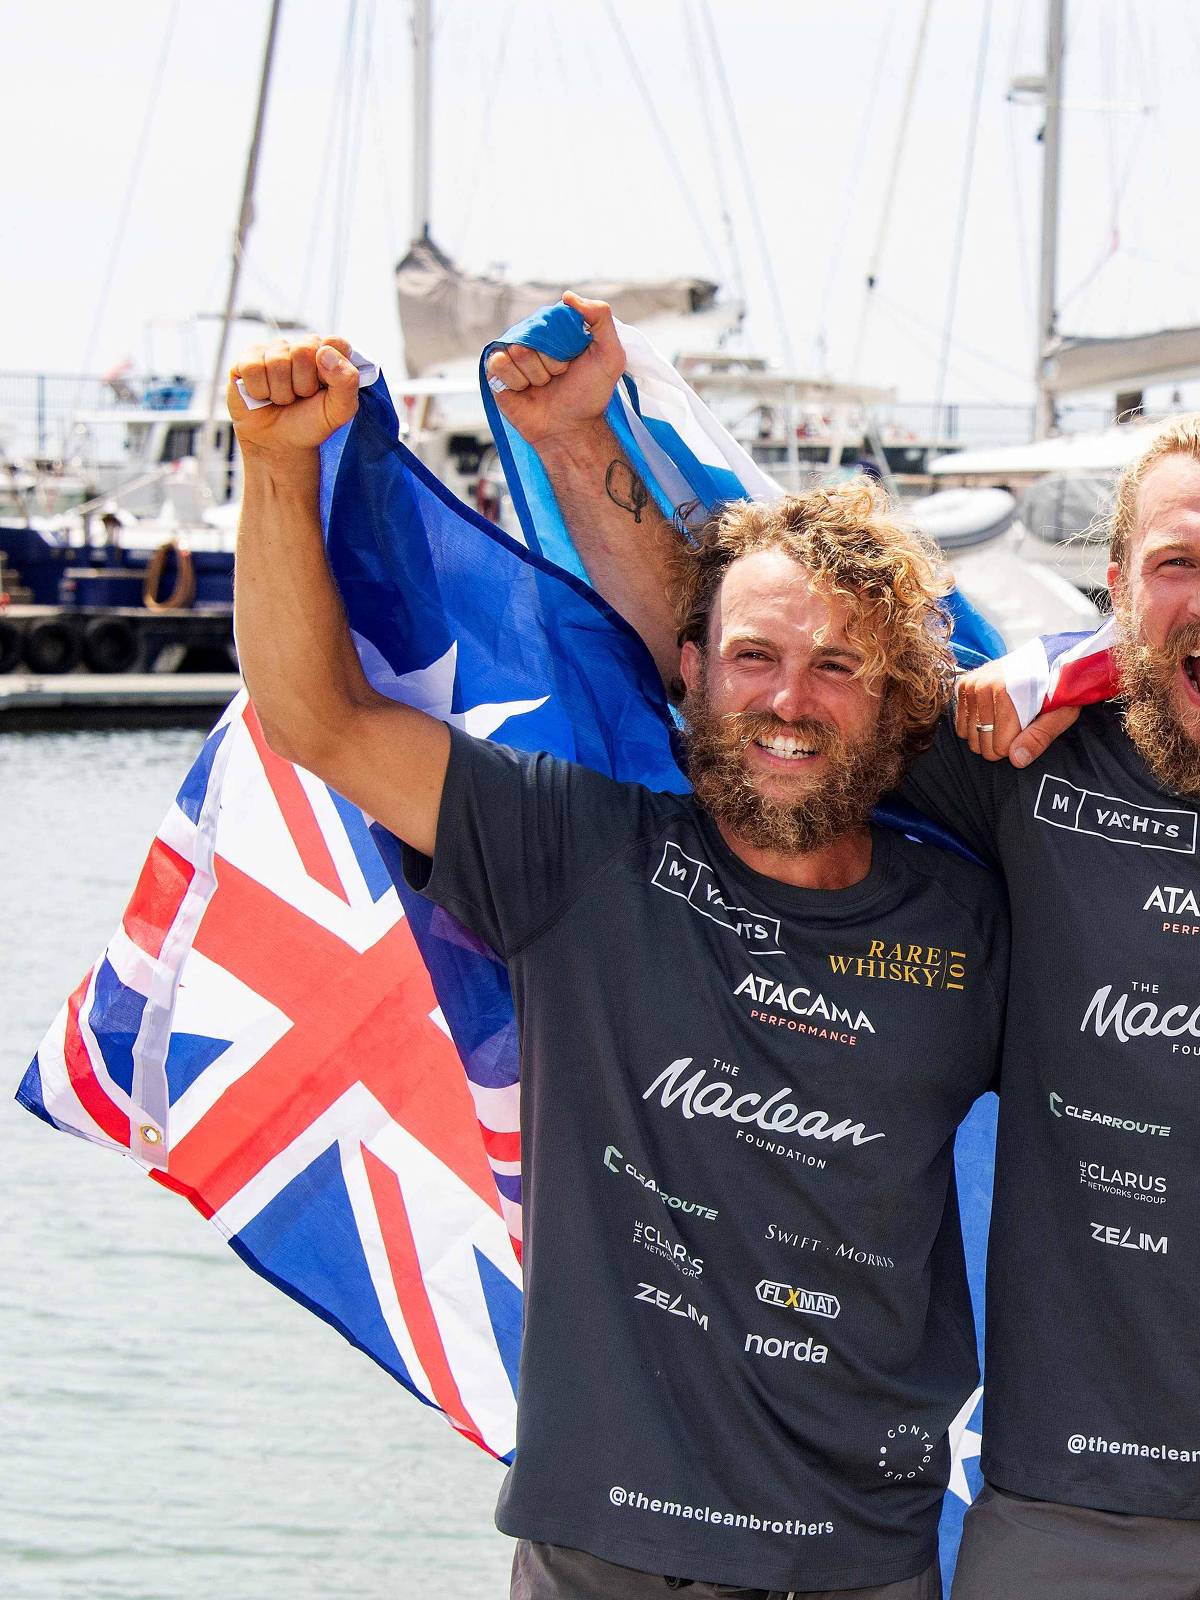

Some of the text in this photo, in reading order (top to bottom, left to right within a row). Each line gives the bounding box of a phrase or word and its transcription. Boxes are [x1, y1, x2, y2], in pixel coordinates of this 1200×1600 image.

[1051, 794, 1180, 838] M YACHTS
[669, 861, 688, 881] M
[867, 940, 942, 966] RARE
[829, 955, 940, 987] WHISKY
[947, 951, 966, 990] 101
[733, 973, 876, 1033] ATACAMA
[1132, 981, 1160, 994] THE
[751, 1010, 857, 1045] PERFORMANCE
[713, 1059, 740, 1077] THE
[642, 1057, 885, 1146] Maclean
[1065, 1105, 1171, 1137] CLEARROUTE
[736, 1130, 827, 1170] FOUNDATION
[1088, 1163, 1167, 1193] CLARUS
[1088, 1181, 1167, 1204] NETWORKS GROUP
[633, 1220, 644, 1243] THE
[765, 1224, 895, 1270] SWIFT MORRIS
[1090, 1222, 1167, 1254] ZELIM
[644, 1226, 704, 1275] CLARS
[634, 1282, 709, 1331] ZELIM
[762, 1284, 836, 1314] FLXMAT
[745, 1333, 829, 1363] norda
[609, 1486, 834, 1535] @themacleanbrothers
